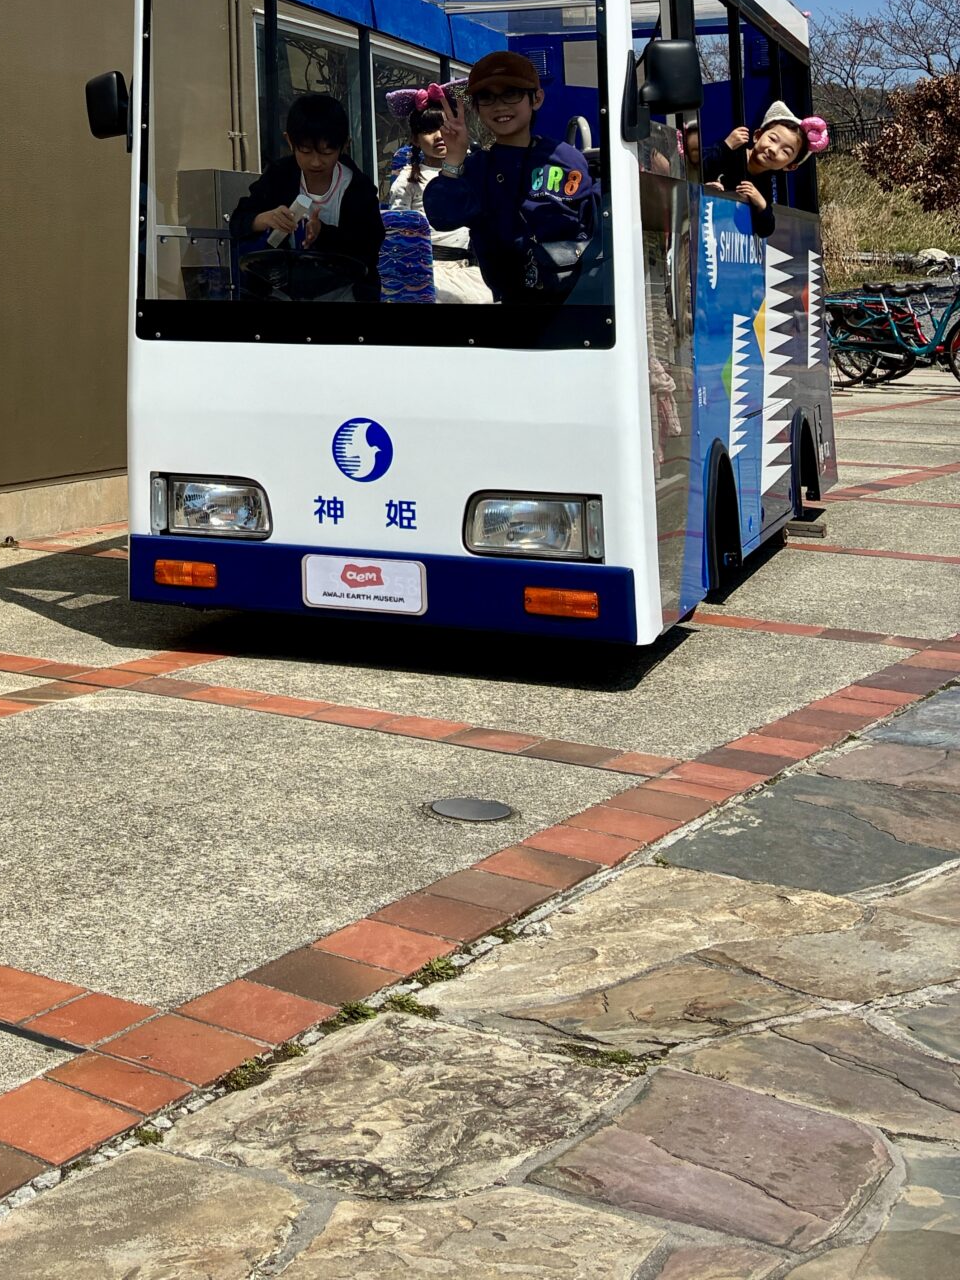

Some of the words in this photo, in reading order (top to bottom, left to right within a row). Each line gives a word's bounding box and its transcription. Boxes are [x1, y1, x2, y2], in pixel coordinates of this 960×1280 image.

[346, 571, 377, 583] aem
[322, 590, 345, 599] AWAJI
[346, 593, 371, 601] EARTH
[373, 595, 405, 604] MUSEUM
